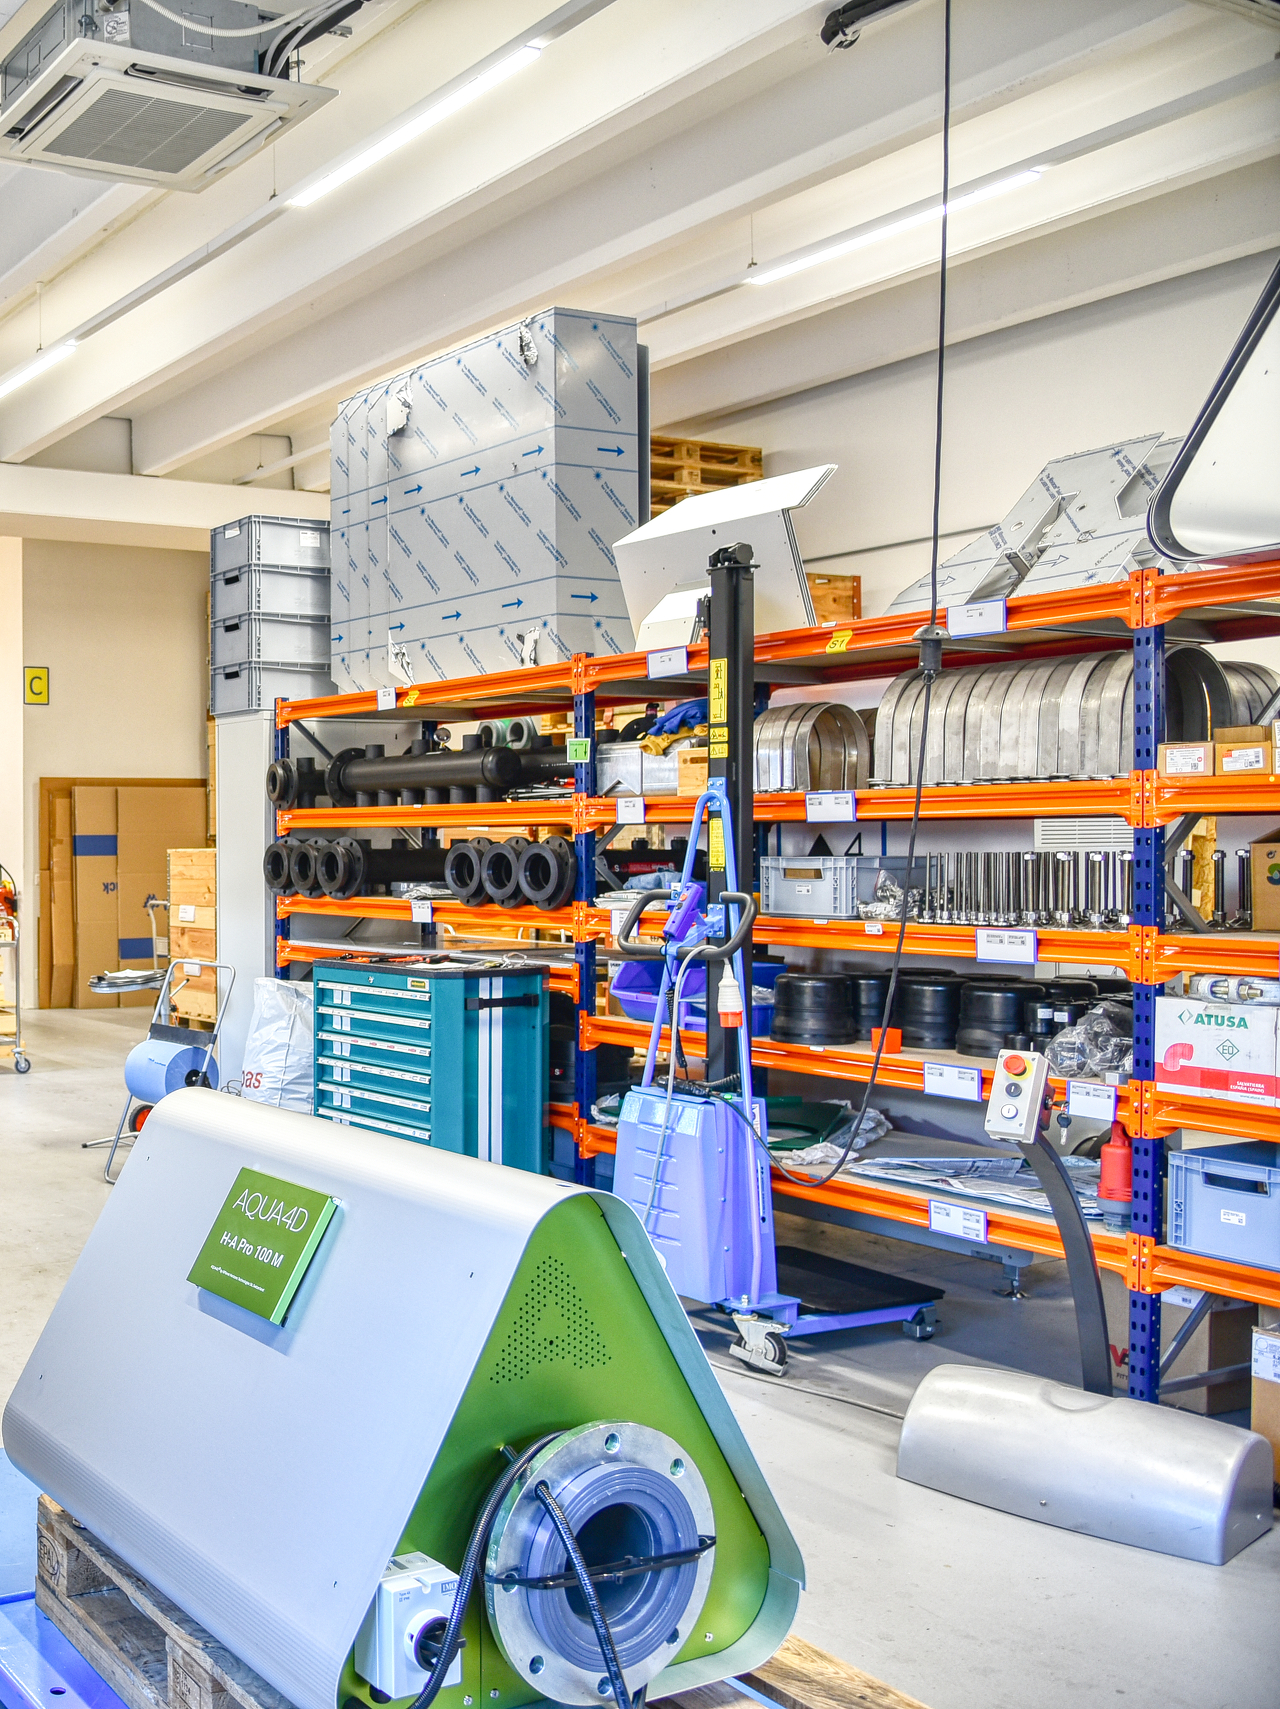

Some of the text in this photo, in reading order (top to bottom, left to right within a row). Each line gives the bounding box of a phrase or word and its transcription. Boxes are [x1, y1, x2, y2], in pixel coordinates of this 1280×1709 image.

[829, 638, 846, 650] S1
[30, 676, 43, 696] C
[574, 748, 578, 758] 1
[103, 882, 118, 894] ck
[1194, 1013, 1248, 1030] ATUSA
[242, 1070, 263, 1089] as
[232, 1188, 309, 1233] AQUA4D
[220, 1230, 284, 1268] H-A Pro 100 M
[442, 1582, 457, 1592] IMO
